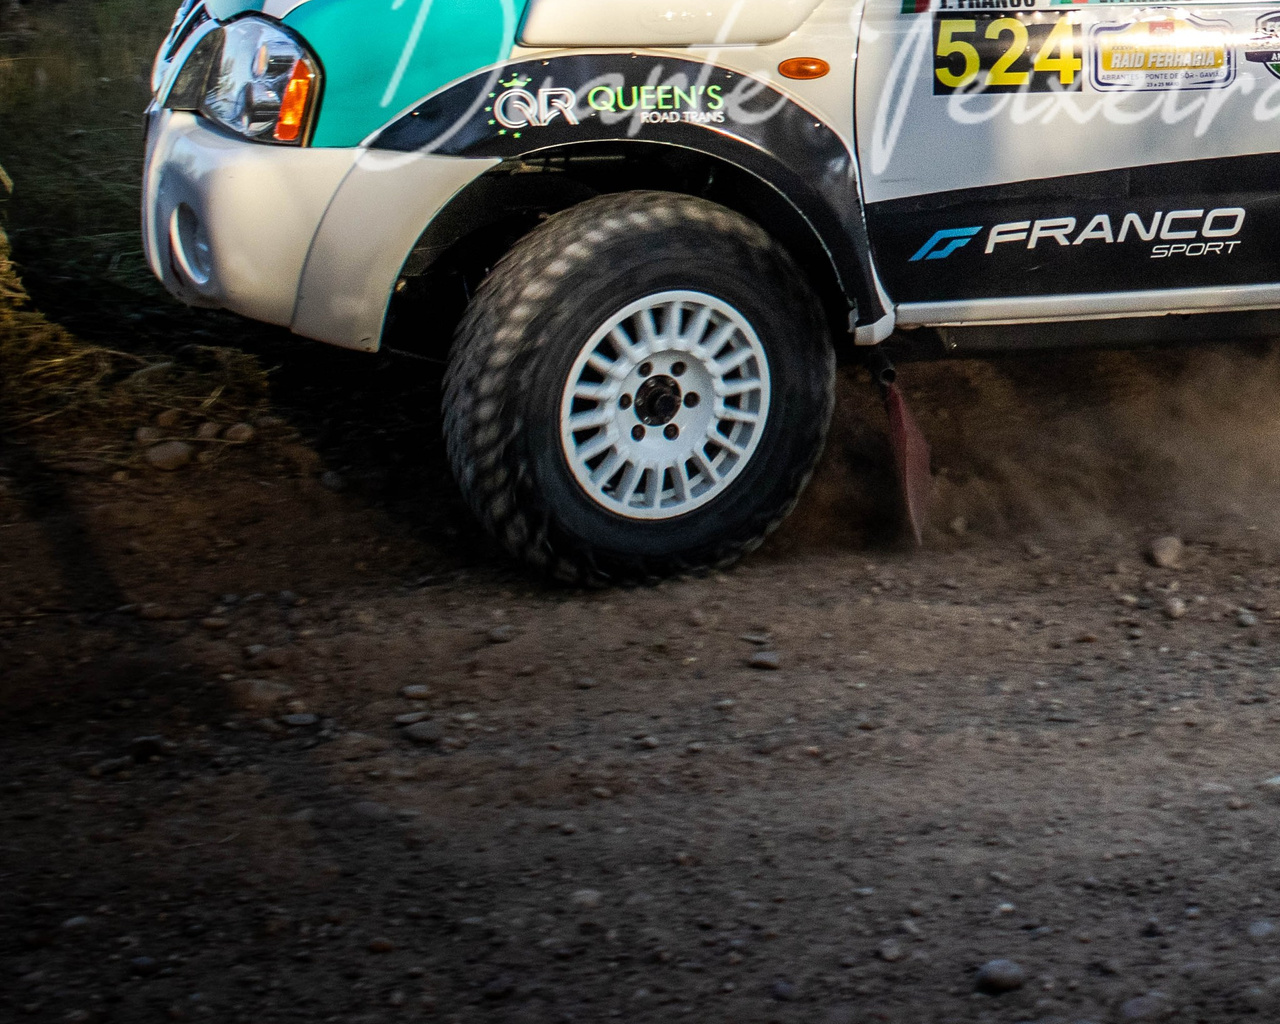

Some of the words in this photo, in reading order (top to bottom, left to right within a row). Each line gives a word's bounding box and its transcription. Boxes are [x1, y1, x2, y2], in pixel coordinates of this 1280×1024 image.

[934, 16, 1083, 88] 524
[1111, 51, 1145, 69] RAID
[1147, 50, 1216, 68] FERRARIA
[588, 83, 725, 112] QUEEN'S
[640, 111, 680, 124] ROAD
[682, 111, 725, 124] TRANS
[985, 207, 1247, 255] FRANCO
[1150, 240, 1242, 259] SPORT
